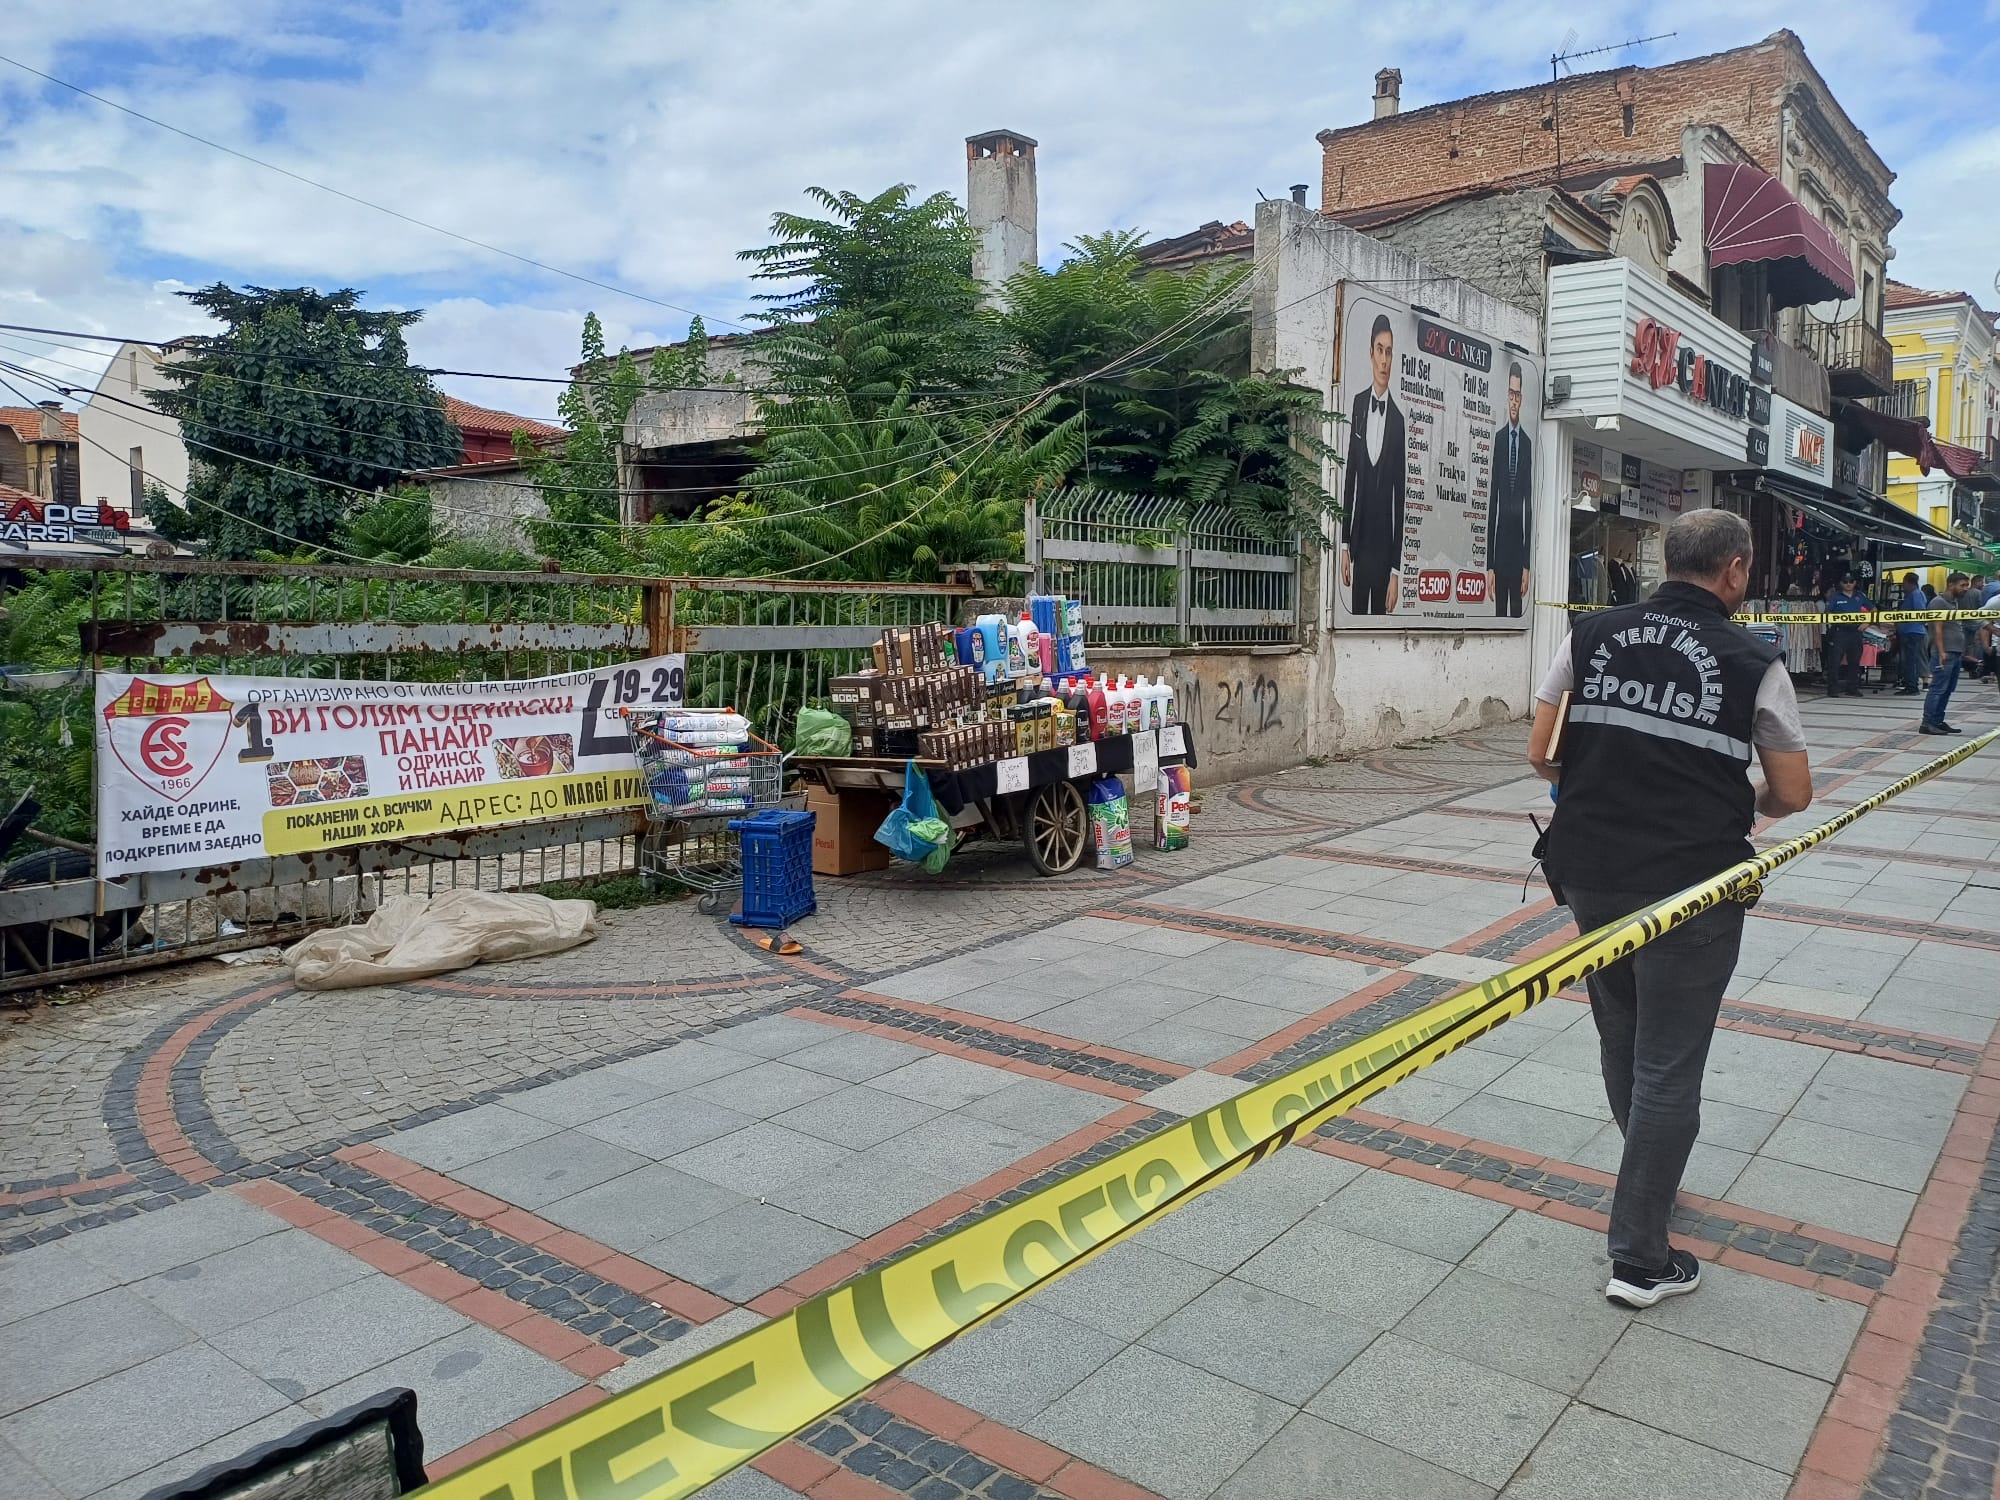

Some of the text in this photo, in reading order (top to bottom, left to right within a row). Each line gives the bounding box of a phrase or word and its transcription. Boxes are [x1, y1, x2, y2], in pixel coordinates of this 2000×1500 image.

[1449, 339, 1488, 367] CANKAT
[1401, 354, 1430, 381] Full Set
[1464, 373, 1489, 398] Full Set
[1678, 347, 1749, 420] CANKAT
[1408, 437, 1429, 452] Gömlek
[1447, 441, 1460, 457] Bir
[1407, 462, 1422, 475] Yelek
[1438, 462, 1466, 484] Trakya
[1406, 486, 1425, 500] Kravat
[1404, 512, 1423, 525] Kemer
[1404, 536, 1421, 551] Çorap
[613, 667, 684, 705] 19-29
[1583, 624, 1723, 726] OLAY YERİ İNCELEME
[248, 686, 389, 703] ОРГАНИЗИРАНО
[394, 685, 414, 698] ОТ
[1601, 675, 1696, 719] POLİS
[316, 703, 422, 731] ГОЛЯМ
[427, 695, 574, 726] ОДРИНСКИ
[379, 723, 493, 756] ПАНАИР
[397, 750, 482, 774] ОДРИНСК
[160, 778, 191, 791] 1966
[399, 767, 485, 790] И ПАНАИР
[121, 799, 241, 823] ХАЙДЕ ОДРИНЕ,
[440, 795, 522, 825] АДРЕС:
[530, 790, 557, 815] ДО
[563, 776, 608, 807] MARGİ
[286, 799, 432, 830] ПОКАНЕНИ СА ВСИЧКИ
[142, 819, 226, 840] ВРЕМЕ Е ДА
[322, 819, 405, 842] НАШИ ХОРА
[1095, 823, 1104, 849] ARIEL
[105, 833, 262, 864] ПОДКРЕПИМ ЗАЕДНО
